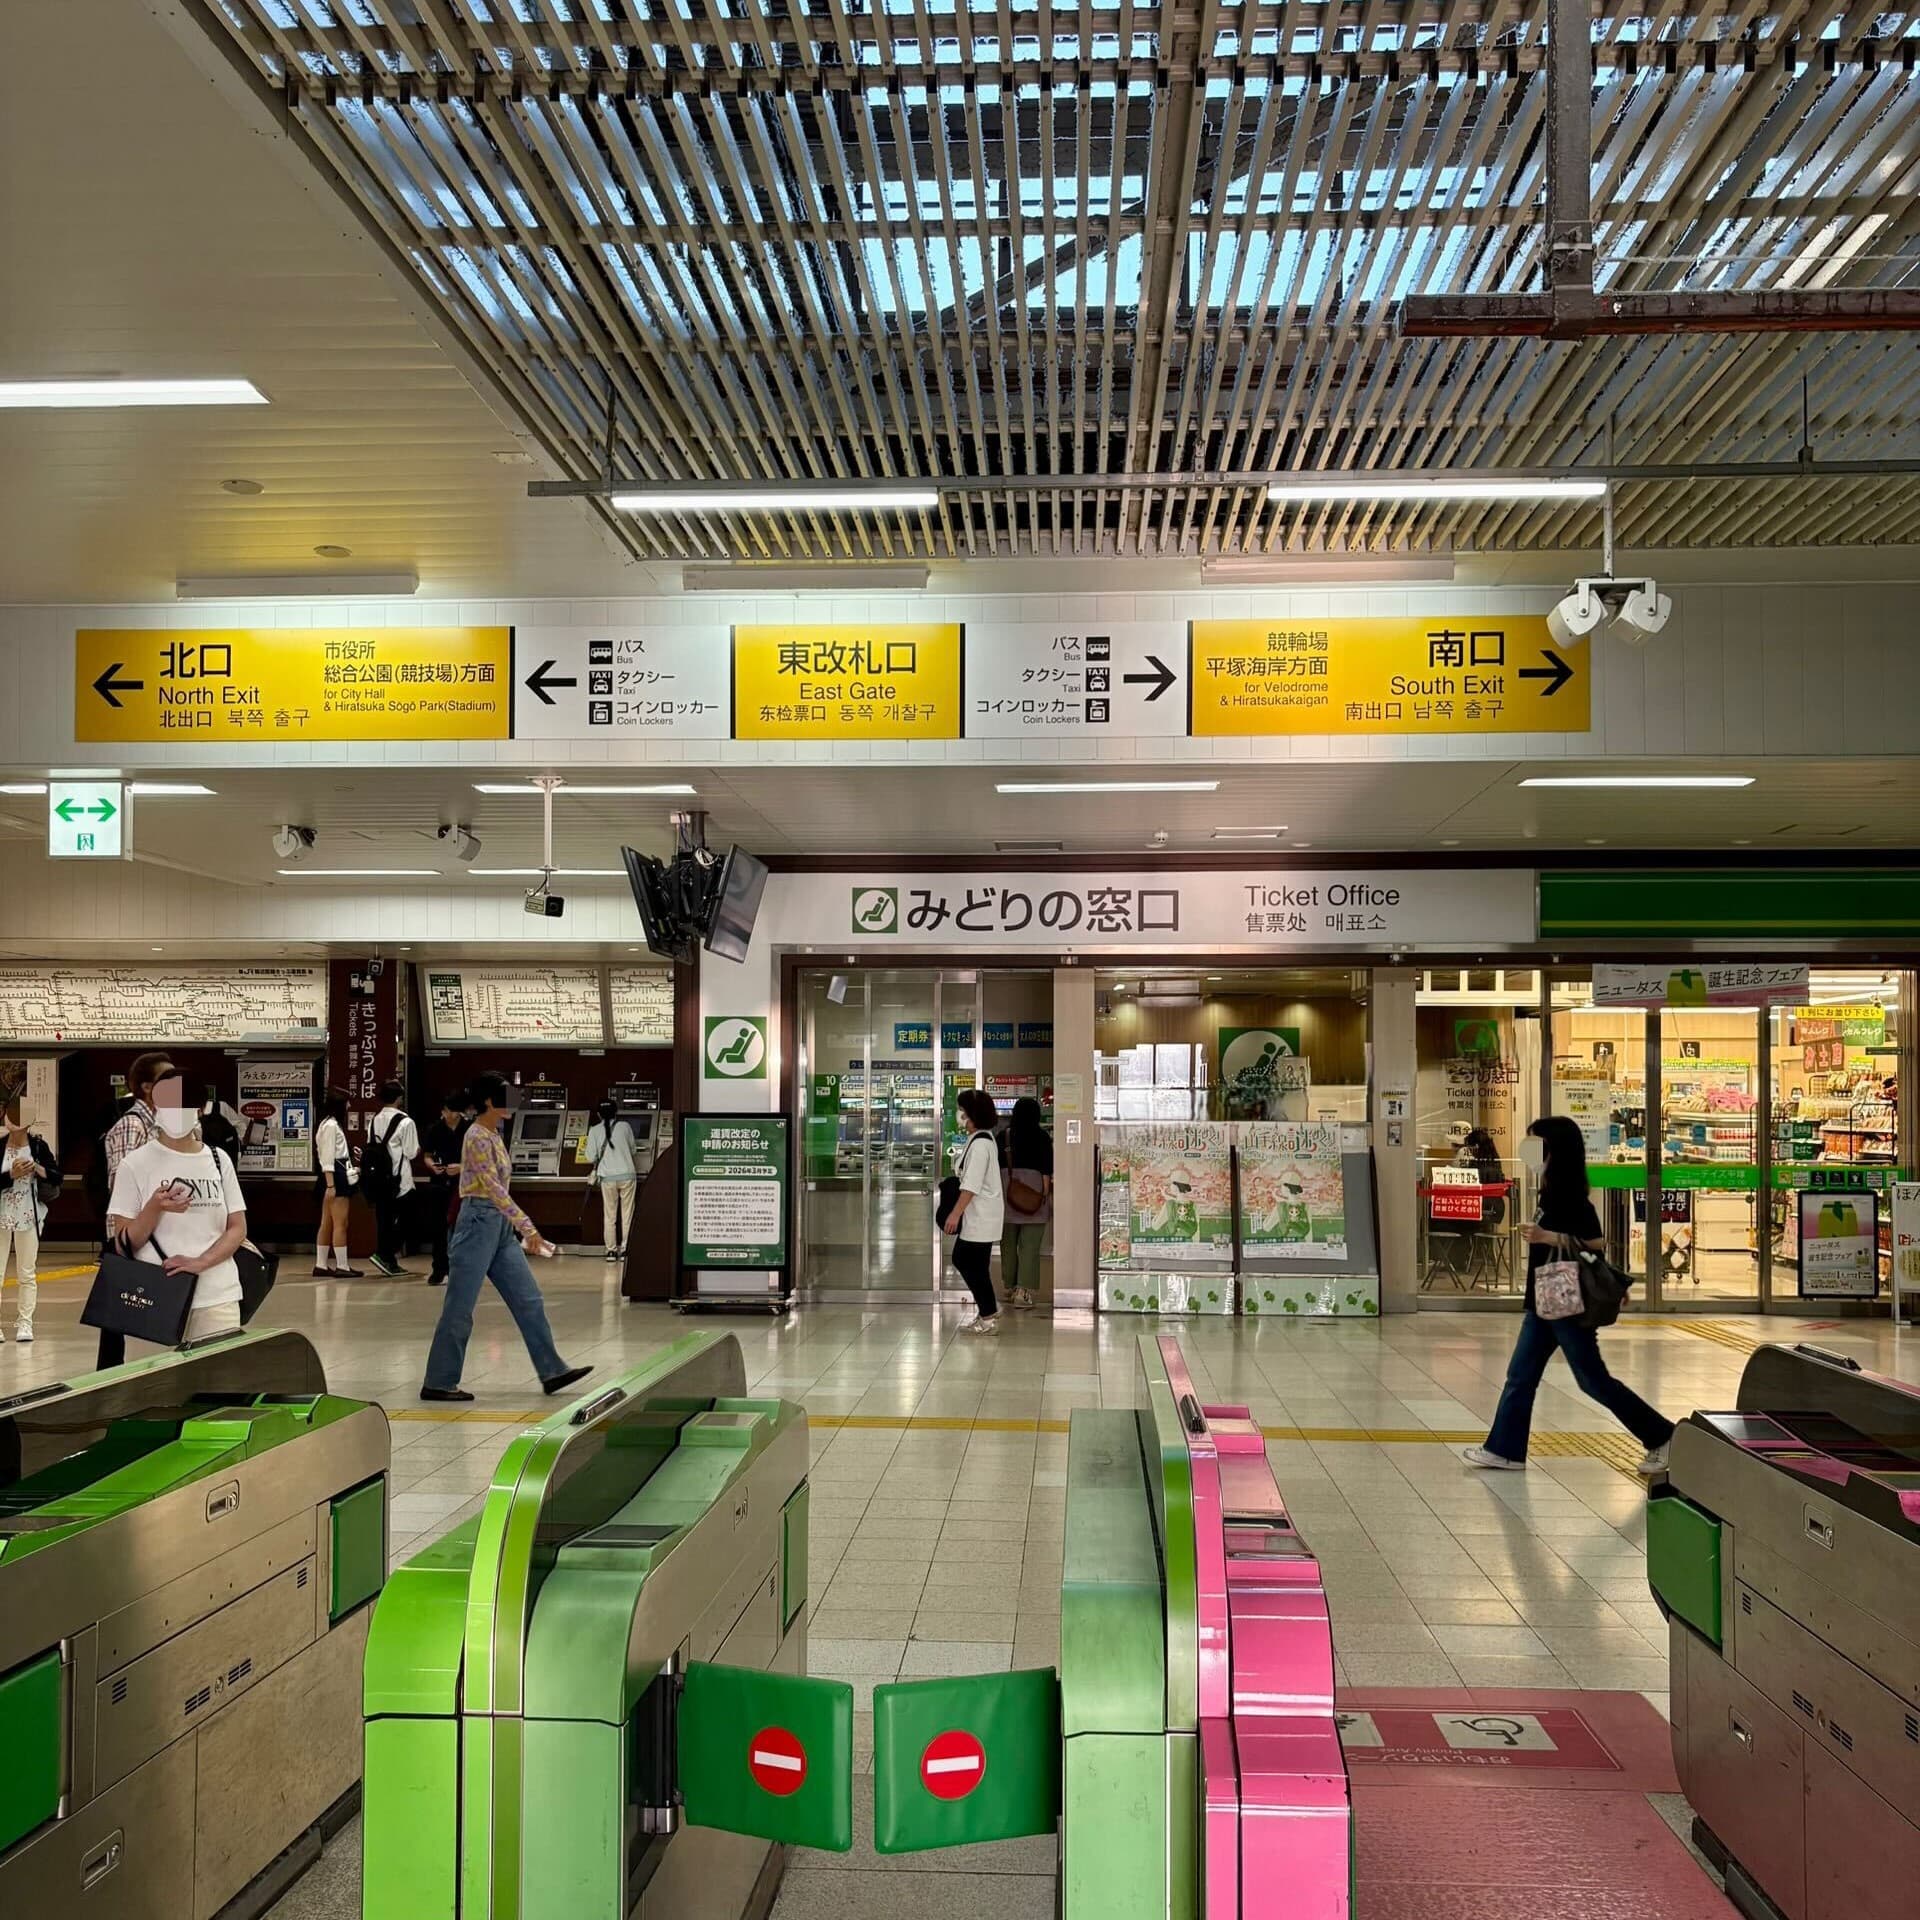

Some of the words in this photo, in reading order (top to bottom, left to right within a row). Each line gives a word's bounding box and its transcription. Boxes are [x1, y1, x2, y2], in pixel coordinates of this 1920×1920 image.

[617, 640, 645, 654] バス
[1052, 636, 1081, 651] バス
[1267, 631, 1329, 652] 競輪場
[1427, 629, 1505, 668] 南口
[324, 640, 376, 660] 市役所
[777, 640, 917, 675] 東改札口
[1064, 652, 1081, 662] Bus
[159, 642, 232, 679] 北口
[616, 655, 634, 664] Bus
[1206, 656, 1329, 678] 平塚海岸方面
[324, 663, 496, 684] 総合公園(競技場)方面
[591, 671, 612, 679] TAXI
[617, 670, 675, 685] タクシー
[1021, 668, 1081, 683] タクシー
[1087, 668, 1109, 676] TAXI
[617, 686, 636, 695] Taxi
[800, 683, 842, 700] East
[849, 682, 896, 700] Gate
[1062, 684, 1081, 693] Taxi
[1244, 682, 1260, 693] for
[1264, 682, 1329, 693] Velodrome
[1391, 675, 1455, 697] South
[1464, 675, 1505, 695] Exit
[159, 686, 214, 705] North
[222, 686, 260, 705] Exit
[323, 688, 338, 699] for
[340, 688, 362, 701] City
[364, 688, 385, 699] Hall
[1219, 696, 1229, 706] &
[1232, 694, 1329, 708] Hiratsukakaigan
[323, 701, 331, 712] &
[334, 700, 385, 712] Hiratsuka
[419, 700, 496, 713] Park(Stadium)
[617, 701, 719, 715] コインロッカー
[759, 704, 827, 722] 东检票口
[839, 703, 874, 722] 동쪽
[882, 703, 937, 722] 개찰구
[976, 699, 1081, 714] コインロッカー
[1345, 701, 1402, 721] 南出口
[1413, 700, 1454, 721] 남쪽
[1463, 699, 1505, 720] 출구
[159, 709, 213, 729] 北出口
[227, 708, 265, 728] 북쪽
[273, 708, 311, 728] 출구
[616, 716, 637, 726] Coin
[639, 716, 674, 726] Lockers
[1022, 715, 1043, 725] Coin
[1046, 715, 1081, 725] Lockers
[1244, 885, 1319, 907] Ticket
[1327, 884, 1400, 907] Office
[906, 886, 1180, 932] みどりの窓口
[1244, 911, 1307, 933] 售票处
[1325, 911, 1387, 933] 매표소
[1596, 980, 1663, 996] ニュータス
[348, 1001, 358, 1038] Tickets
[897, 1029, 929, 1044] 定期券
[361, 1001, 377, 1099] きっぷうりば
[243, 1071, 306, 1081] みえるアナウンス
[538, 1072, 546, 1081] 6
[631, 1072, 638, 1081] 7
[826, 1075, 837, 1086] 10
[1446, 1087, 1475, 1097] Ticket
[1478, 1087, 1508, 1097] Office
[702, 1139, 769, 1150] 申請のお知らせ
